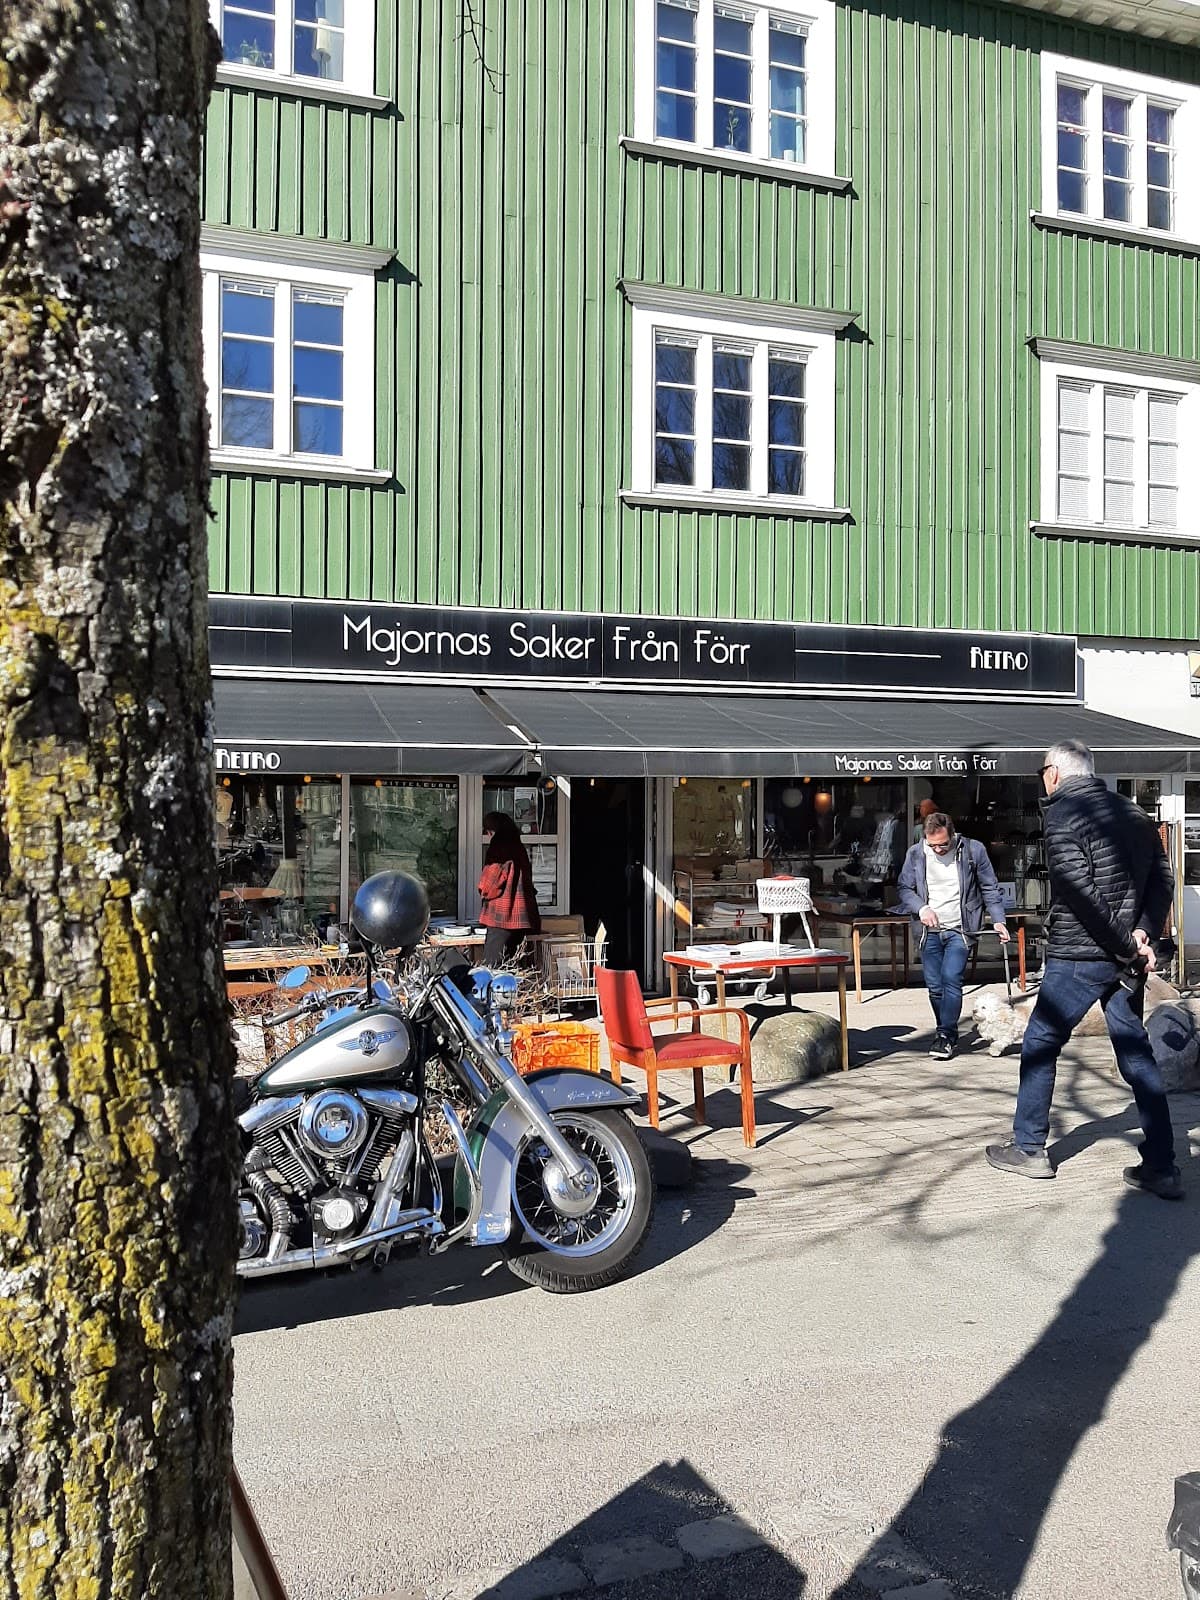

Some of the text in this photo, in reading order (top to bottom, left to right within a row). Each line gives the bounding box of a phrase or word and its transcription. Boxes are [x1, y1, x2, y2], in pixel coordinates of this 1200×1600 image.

[343, 614, 751, 666] Majornas Saker Från Förr
[970, 646, 1029, 671] RETRO
[215, 748, 281, 770] RETRO
[835, 755, 998, 775] Majornas Saker Från Förr
